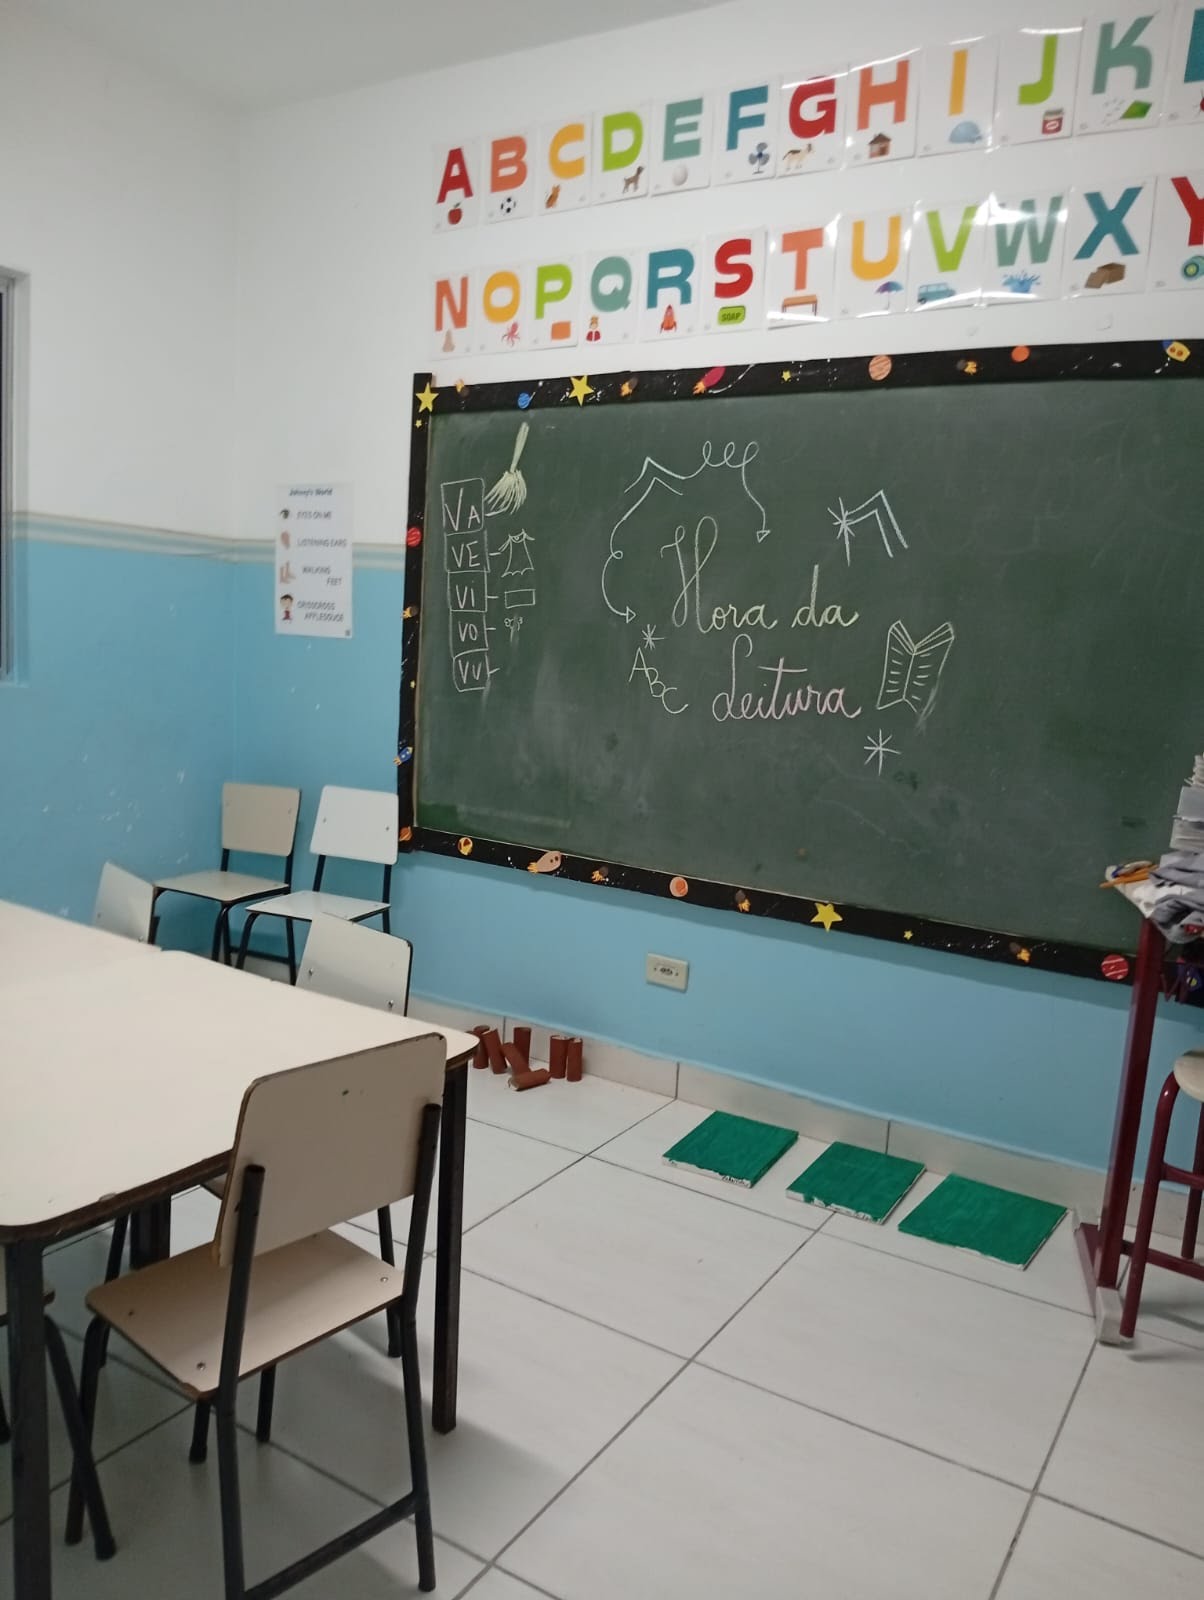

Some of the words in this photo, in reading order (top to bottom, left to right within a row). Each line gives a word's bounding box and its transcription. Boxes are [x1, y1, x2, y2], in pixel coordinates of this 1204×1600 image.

[437, 147, 474, 204] A
[490, 135, 528, 193] B
[548, 122, 586, 180] C
[602, 111, 644, 172] D
[663, 97, 704, 162] E
[726, 85, 769, 151] F
[788, 76, 838, 139] G
[857, 59, 910, 131] H
[948, 49, 969, 117] I
[1018, 34, 1058, 106] J
[1092, 14, 1155, 95] K
[435, 276, 469, 332] N
[482, 270, 521, 324] O
[535, 263, 573, 320] P
[590, 256, 633, 313] Q
[646, 248, 695, 309] R
[714, 238, 754, 299] S
[781, 227, 824, 291] T
[850, 215, 902, 281] U
[926, 205, 979, 273] V
[994, 195, 1064, 268] W
[1074, 186, 1144, 260] X
[721, 312, 741, 322] SOAP
[444, 487, 481, 531] VA
[452, 541, 481, 568] VE
[660, 516, 777, 633] Hora
[792, 564, 860, 627] da
[458, 621, 478, 642] VO
[629, 648, 688, 714] ABC
[712, 634, 862, 722] Leitura
